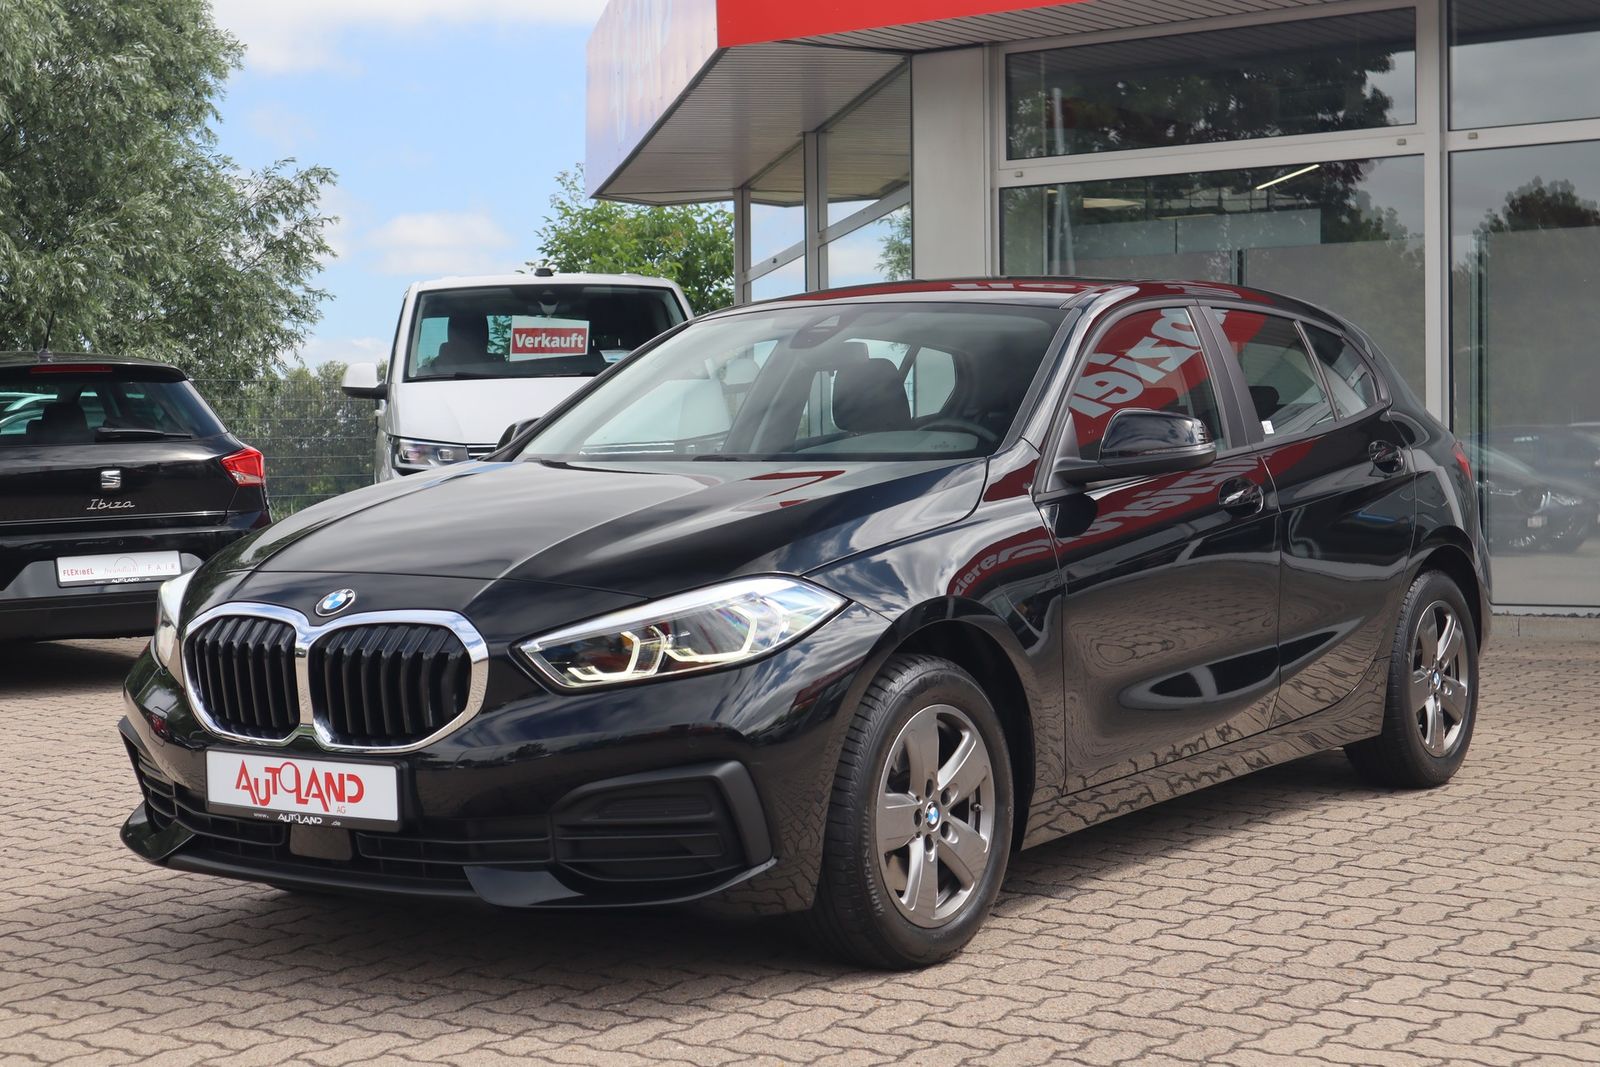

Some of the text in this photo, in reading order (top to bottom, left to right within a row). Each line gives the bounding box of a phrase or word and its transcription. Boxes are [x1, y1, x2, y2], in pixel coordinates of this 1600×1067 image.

[515, 333, 584, 348] Verkauft
[86, 499, 136, 510] Ibiza
[62, 568, 95, 577] FLEXIBEL
[235, 759, 365, 813] AUTOLAND
[336, 805, 346, 814] AG
[277, 812, 323, 826] AUTOLAND
